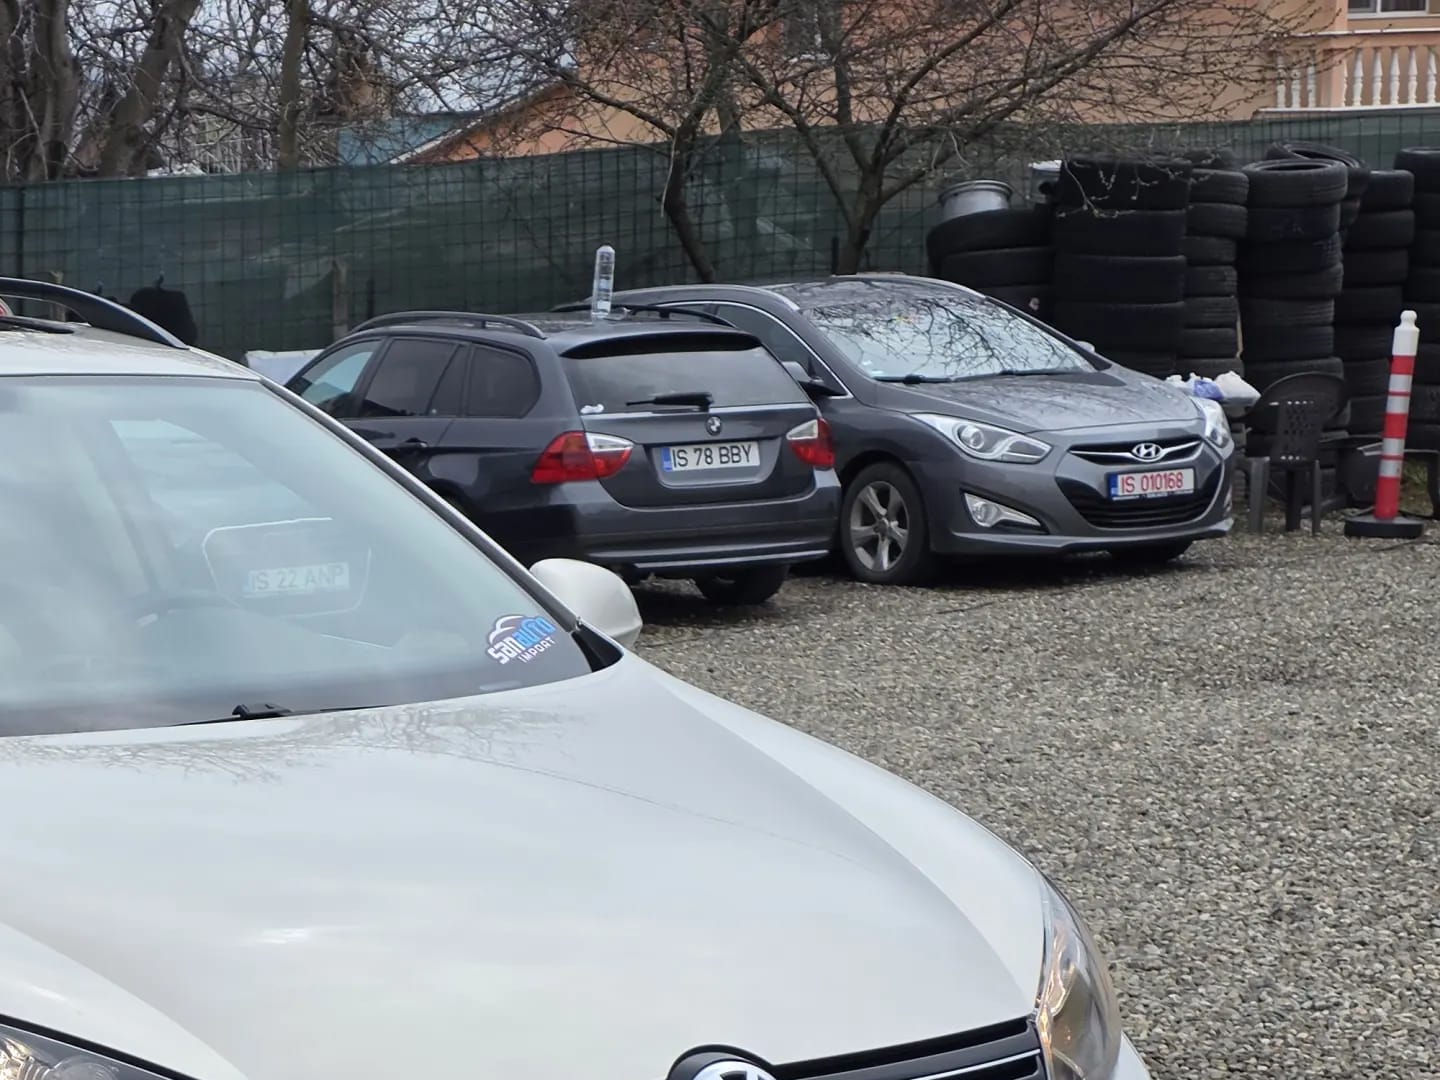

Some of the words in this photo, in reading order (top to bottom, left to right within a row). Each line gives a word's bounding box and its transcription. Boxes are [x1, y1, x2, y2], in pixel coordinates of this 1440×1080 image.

[672, 449, 689, 468] IS
[693, 447, 713, 466] 78
[719, 443, 752, 464] BBY
[1121, 475, 1136, 493] IS
[1141, 472, 1184, 491] 010168
